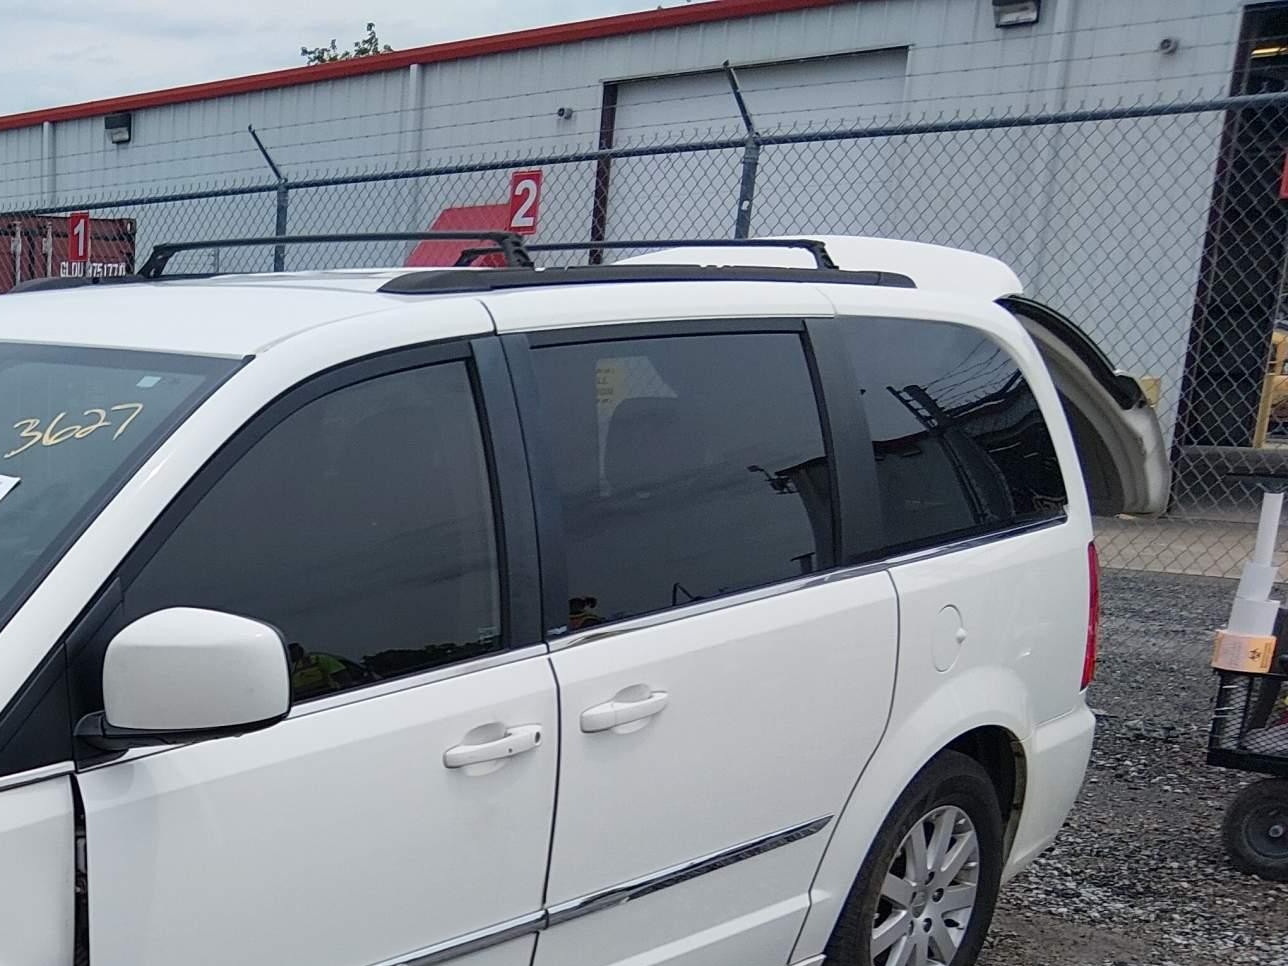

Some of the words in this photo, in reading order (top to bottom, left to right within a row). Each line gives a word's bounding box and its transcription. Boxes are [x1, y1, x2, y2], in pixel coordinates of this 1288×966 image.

[511, 179, 537, 228] 2
[73, 218, 85, 257] 1
[4, 402, 144, 459] 3627
